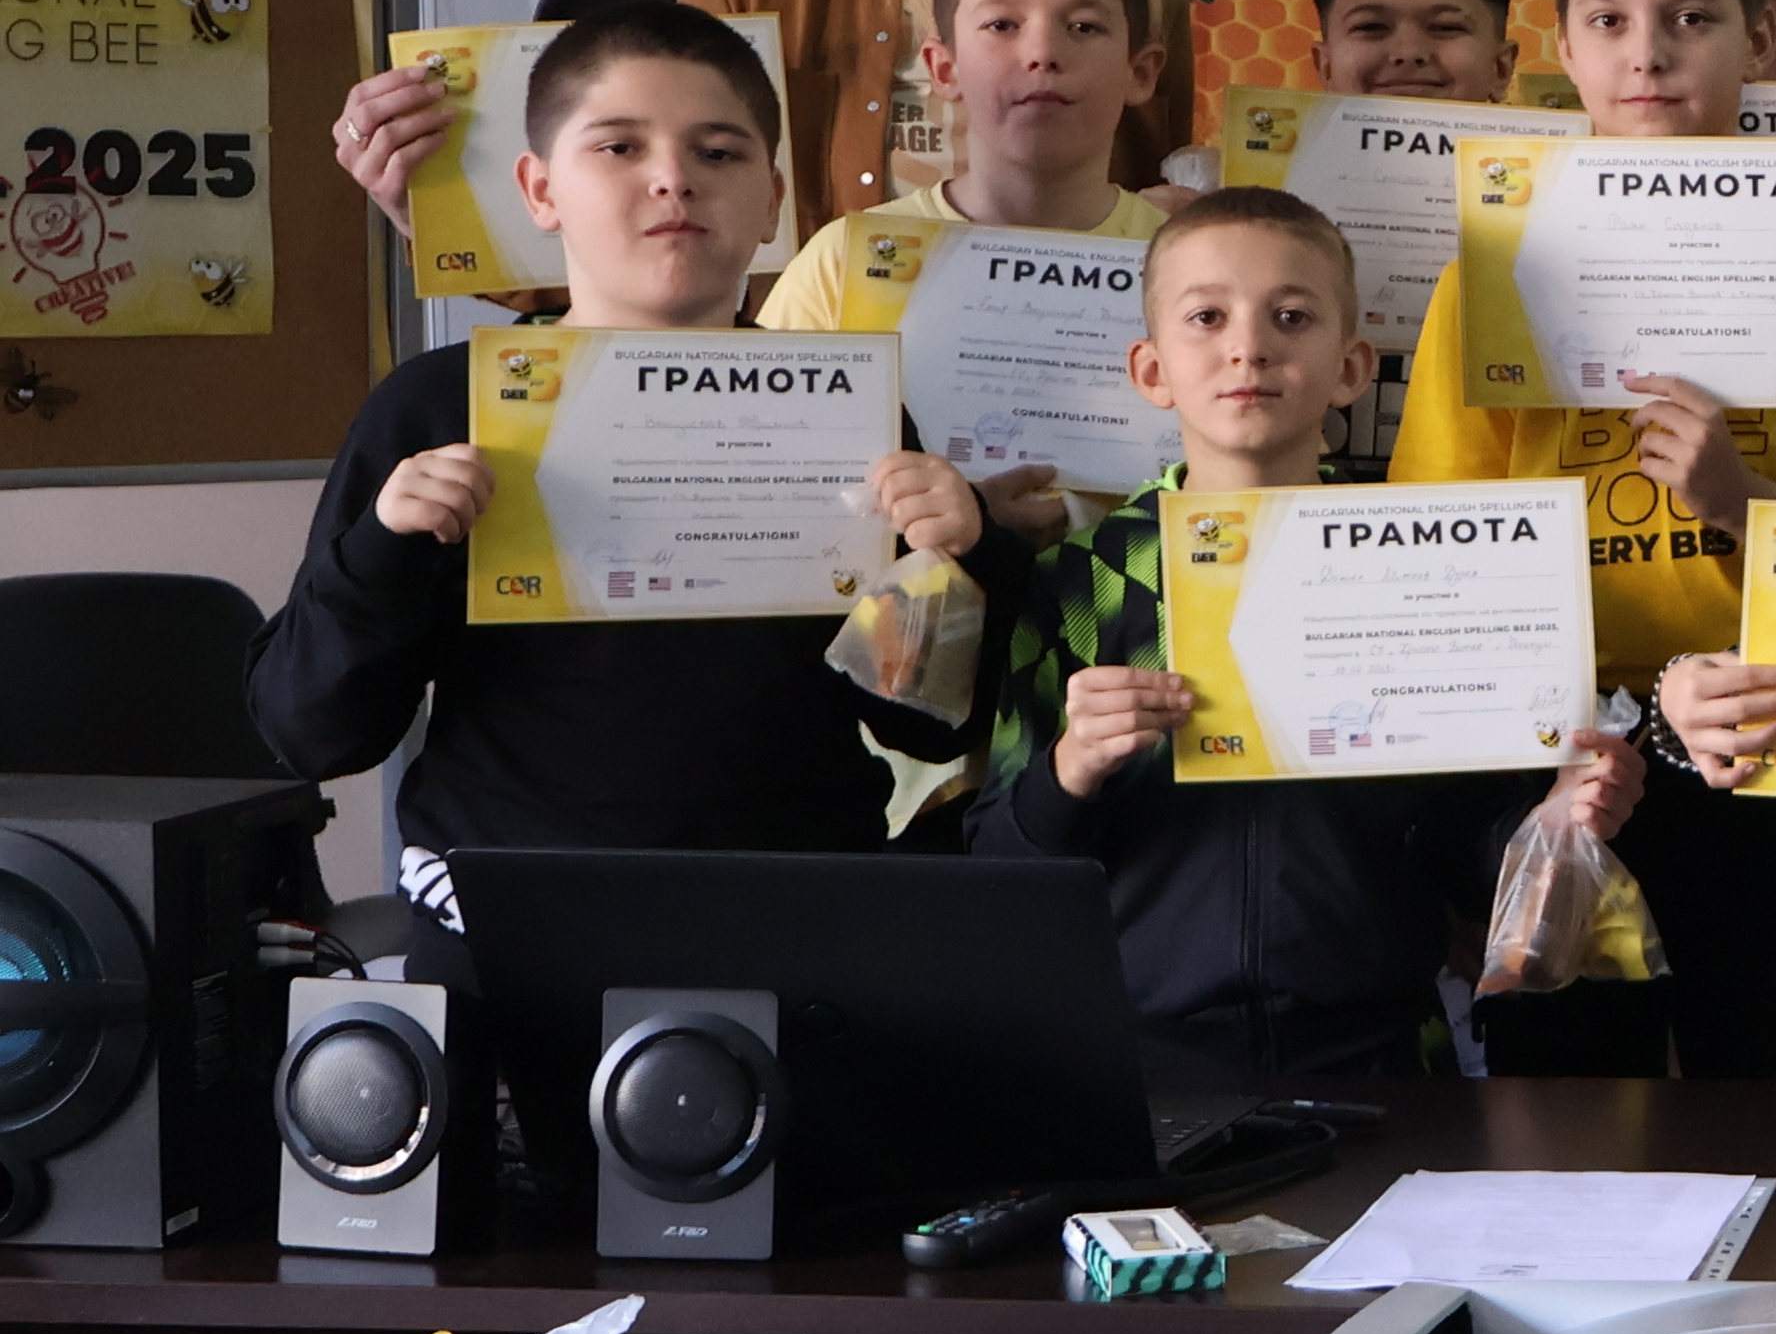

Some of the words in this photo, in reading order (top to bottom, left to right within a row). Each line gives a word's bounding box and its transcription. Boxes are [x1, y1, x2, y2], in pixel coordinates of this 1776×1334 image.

[5, 18, 45, 62] G
[70, 21, 158, 66] BEE
[892, 101, 924, 121] ER
[890, 125, 942, 153] AGE
[1359, 127, 1456, 155] ГРАМ
[1577, 157, 1637, 169] BULGARIAN
[1640, 158, 1692, 169] NATIONAL
[1695, 158, 1739, 169] ENGLISH
[988, 257, 1147, 293] ГРАМО
[1636, 326, 1752, 337] CONGRATULATIONS!
[614, 350, 679, 362] BULGARIAN
[683, 351, 740, 362] NATIONAL
[743, 351, 791, 362] ENGLISH
[795, 352, 849, 363] SPELLING
[852, 352, 873, 363] BEE
[637, 366, 854, 394] ГРАМОТА
[1299, 507, 1364, 518] BULGARIAN
[1368, 505, 1424, 516] NATIONAL
[1427, 503, 1476, 514] ENGLISH
[1479, 501, 1533, 512] SPELLING
[1536, 500, 1558, 510] BEE
[1587, 472, 1701, 526] OU
[675, 531, 800, 542] CONGRATULATIONS!
[1322, 516, 1538, 550] ГРАМОТА
[1589, 533, 1662, 566] ERY
[1670, 528, 1738, 559] BES
[1371, 683, 1497, 697] CONGRATULATIONS!
